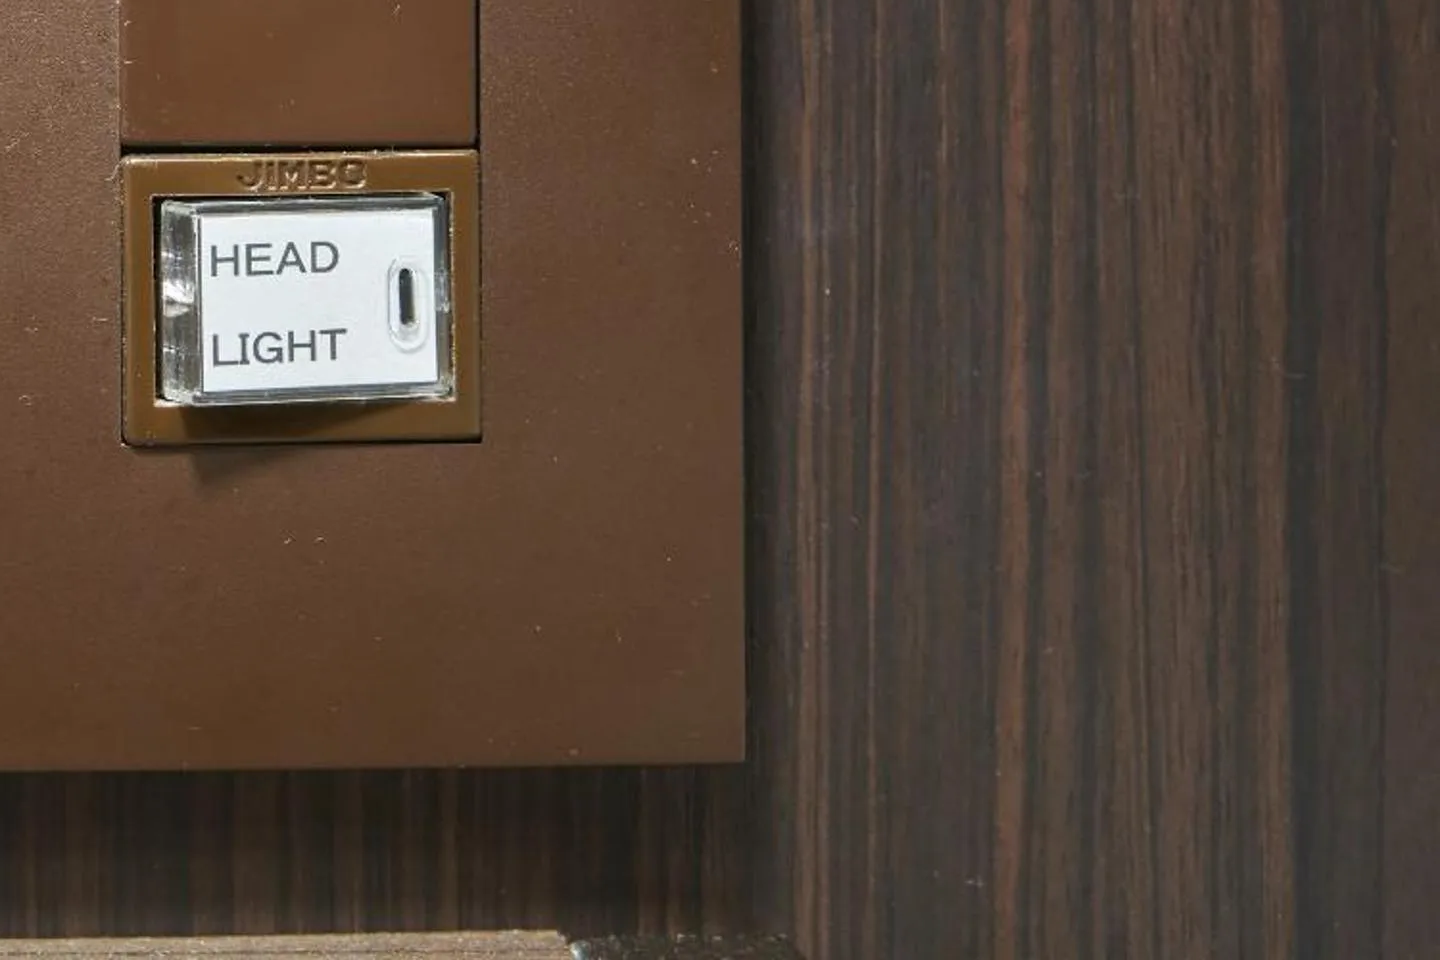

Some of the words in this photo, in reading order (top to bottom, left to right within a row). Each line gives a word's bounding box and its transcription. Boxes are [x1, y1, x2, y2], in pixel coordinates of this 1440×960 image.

[236, 159, 368, 191] JIMBO
[211, 241, 340, 277] HEAD
[212, 328, 349, 367] LIGHT
